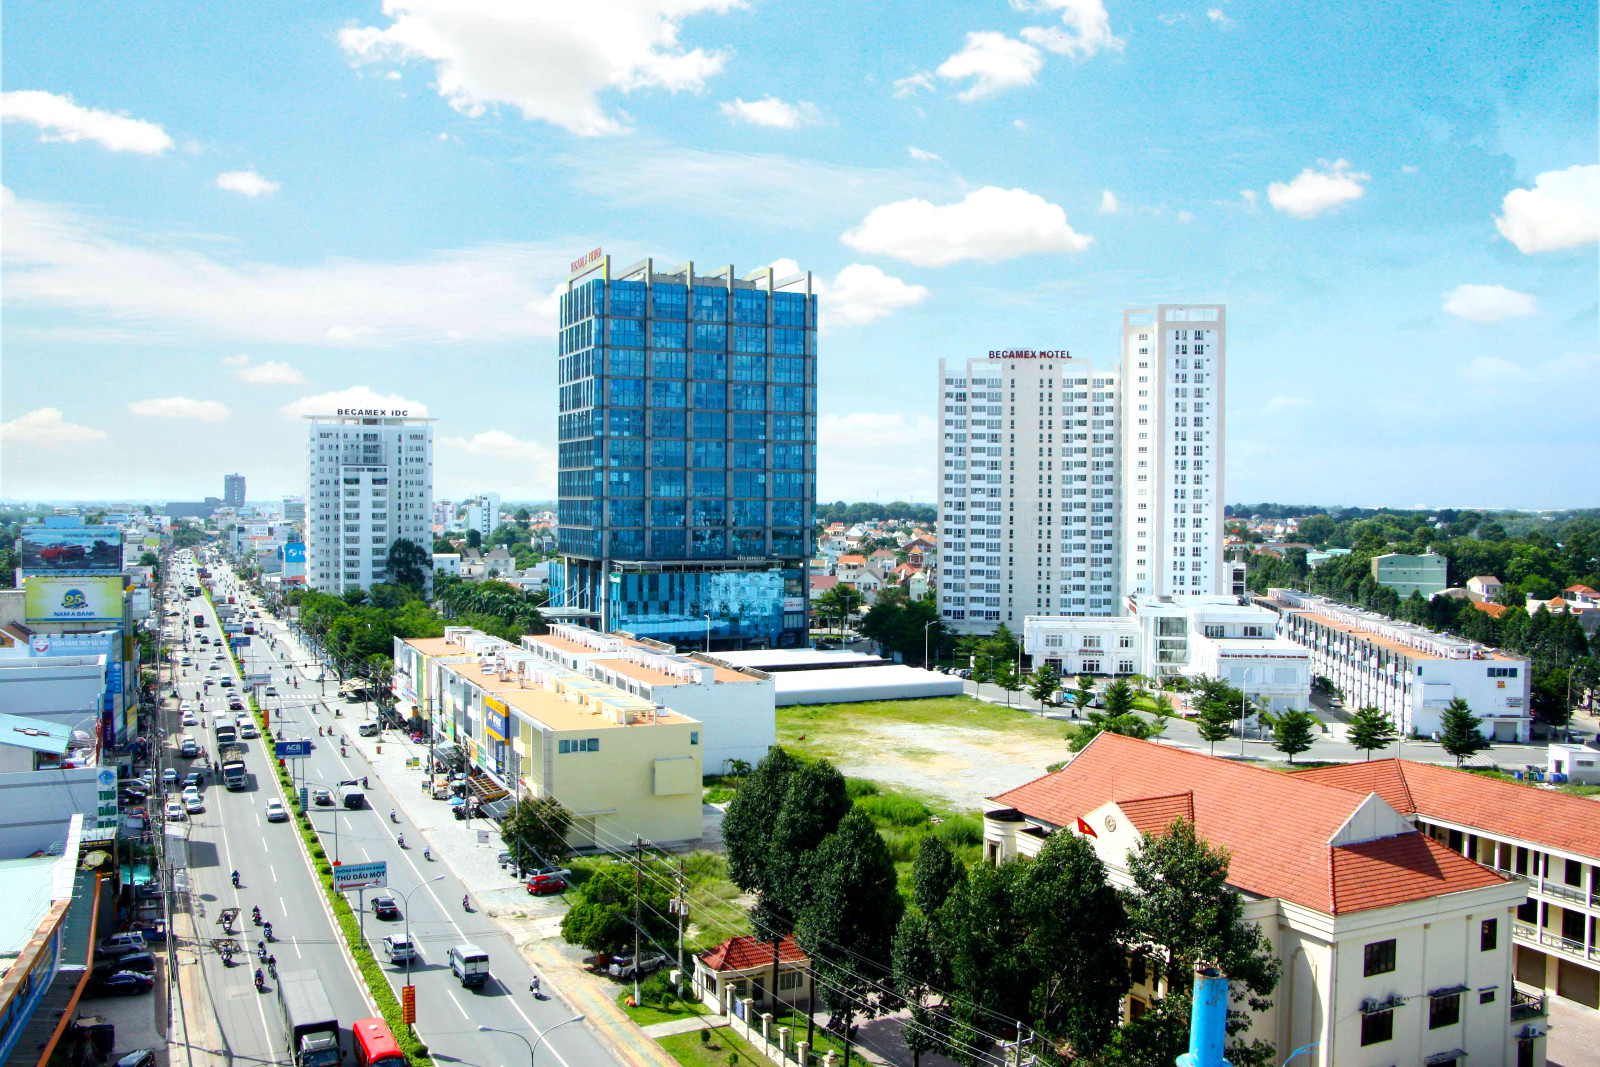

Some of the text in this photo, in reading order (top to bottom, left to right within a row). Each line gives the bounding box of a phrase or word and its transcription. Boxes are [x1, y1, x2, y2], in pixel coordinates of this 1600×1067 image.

[988, 350, 1072, 359] BECAMEX HOTEL
[98, 786, 116, 800] THỦ
[337, 873, 352, 882] THỦ
[353, 871, 368, 880] DẦU
